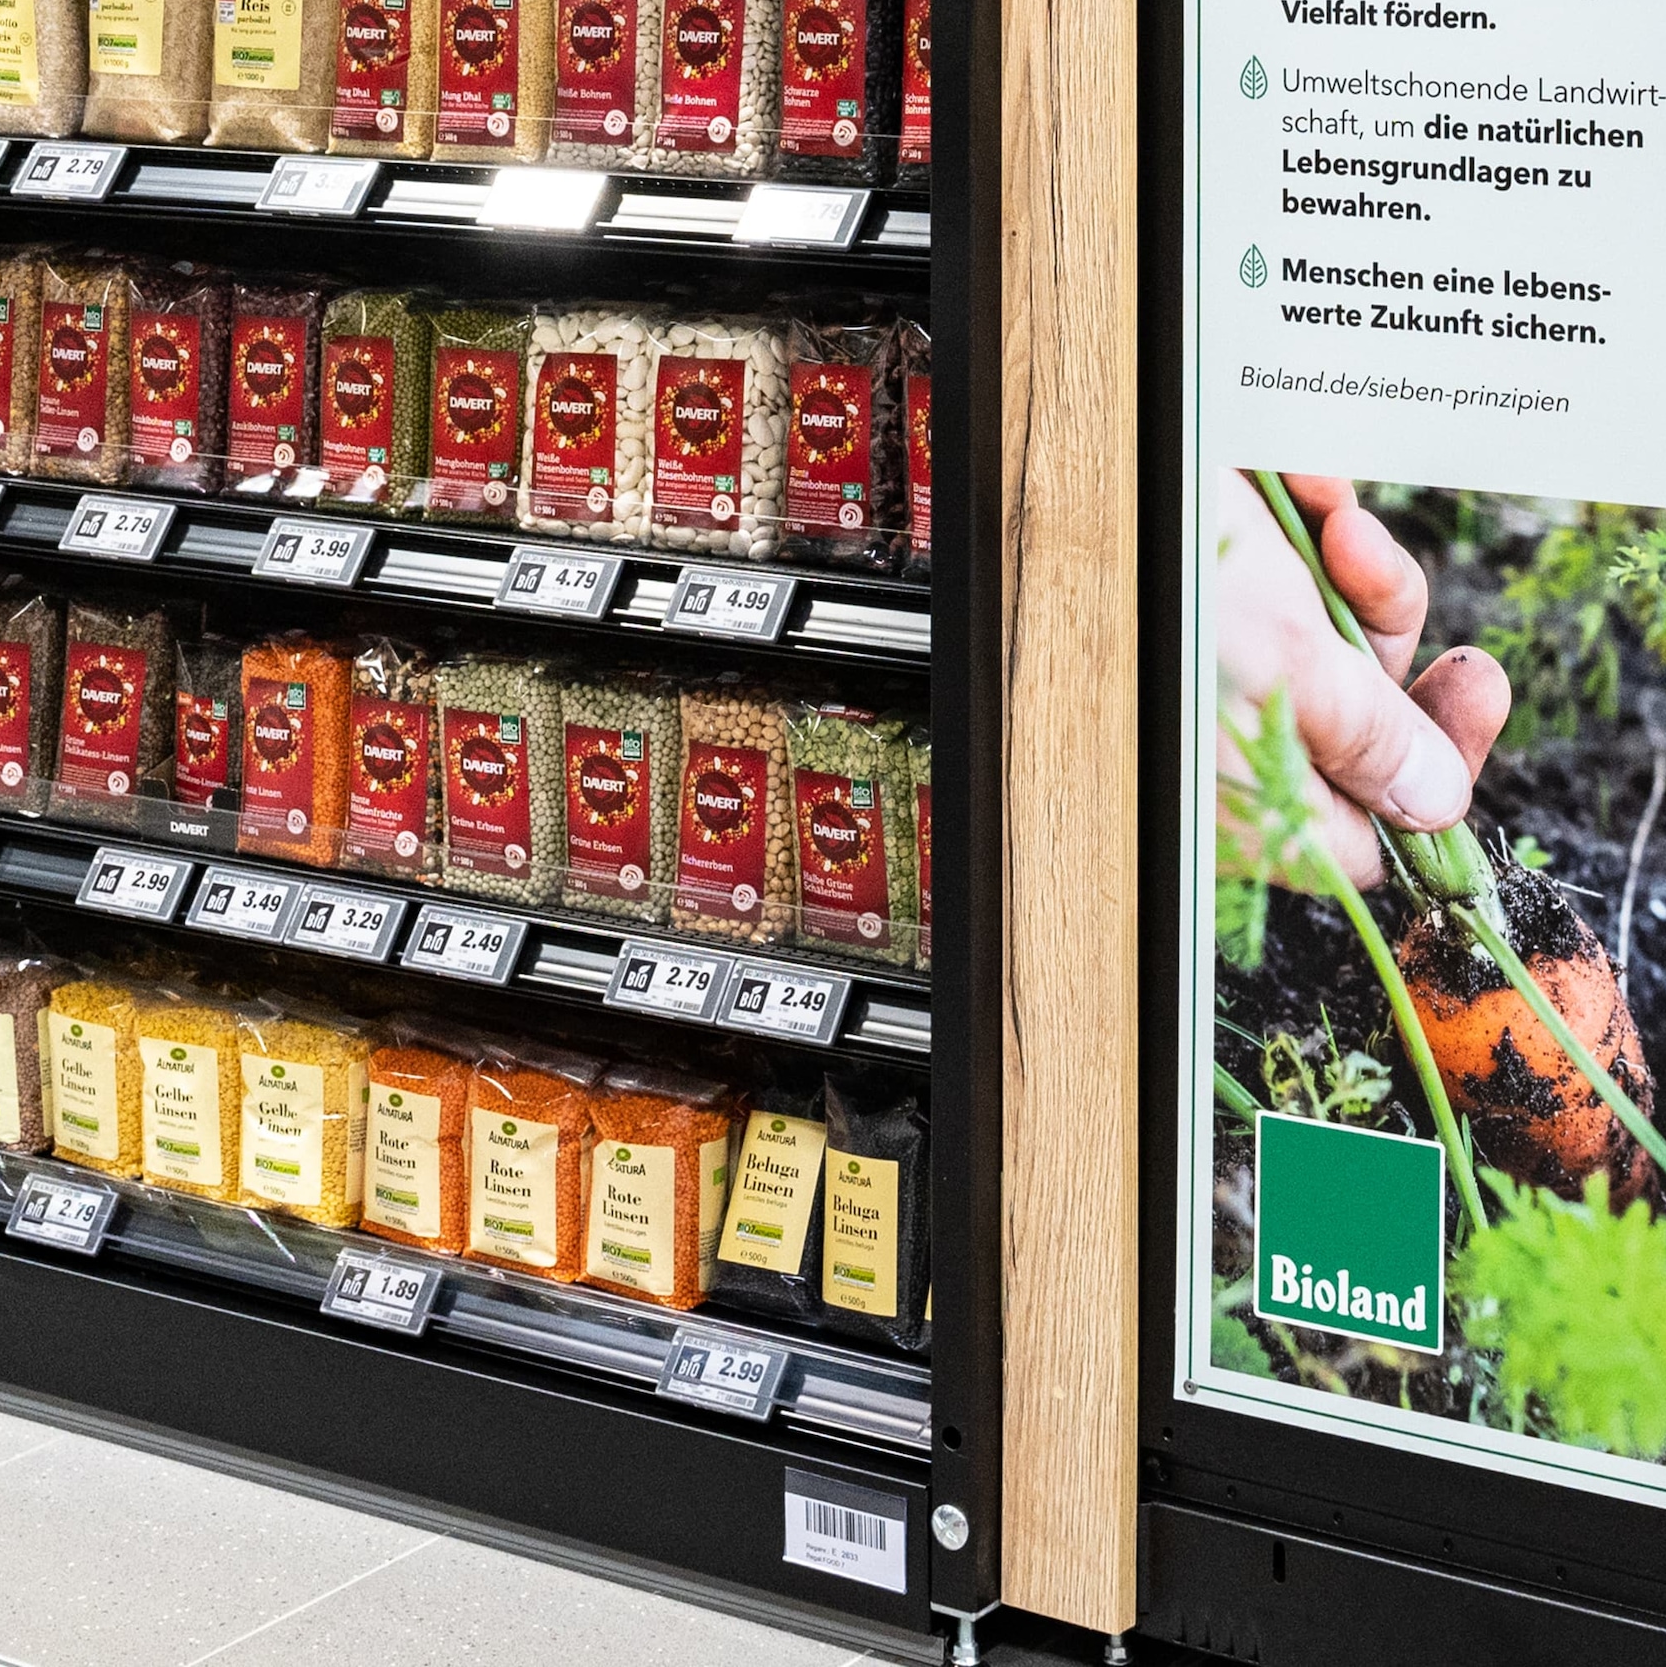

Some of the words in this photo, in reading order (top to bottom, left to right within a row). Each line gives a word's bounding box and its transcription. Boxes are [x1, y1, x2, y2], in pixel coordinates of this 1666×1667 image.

[1281, 0, 1378, 27] Vielfalt
[1383, 2, 1497, 30] fördern.
[678, 31, 719, 45] DAVERT
[784, 86, 820, 98] Schwarze
[1282, 67, 1528, 102] Umweltschonende
[1538, 77, 1666, 108] Landwirt-
[684, 96, 716, 107] Bohnen
[784, 98, 811, 109] Bohnen
[1281, 109, 1365, 140] schaft,
[1374, 120, 1415, 138] um
[1423, 113, 1469, 140] die
[1477, 117, 1644, 149] natürlichen
[1282, 149, 1550, 192] Lebensgrundlagen
[1557, 169, 1592, 189] zu
[1282, 188, 1432, 222] bewahren.
[1282, 258, 1424, 291] Menschen
[1432, 268, 1495, 296] eine
[1503, 270, 1612, 303] lebens-
[1281, 304, 1363, 328] werte
[1370, 304, 1484, 337] Zukunft
[1491, 312, 1607, 345] sichern.
[1239, 365, 1570, 415] Bioland.de/sieben-prinzipien
[676, 406, 719, 421] DAVERT
[435, 457, 486, 471] Mungbohnen
[536, 452, 560, 465] Weiße
[536, 463, 589, 477] Riesenbohnen
[113, 514, 153, 535] 2.79
[554, 567, 598, 591] 4.79
[170, 821, 208, 837] DAVERT
[452, 816, 478, 830] Grüne
[479, 821, 504, 835] Erbsen
[682, 853, 734, 872] Kichererbsen
[130, 870, 170, 894] 2.99
[460, 929, 504, 954] 2.49
[779, 986, 827, 1013] 2.49
[155, 1084, 193, 1103] Gelbe
[154, 1102, 198, 1121] Linsen
[489, 1158, 524, 1179] Rote
[746, 1155, 800, 1181] Beluga
[484, 1176, 532, 1197] Linsen
[743, 1174, 794, 1198] Linsen
[58, 1198, 97, 1223] 2.79
[1271, 1255, 1426, 1331] Bioland
[717, 1356, 765, 1384] 2.99
